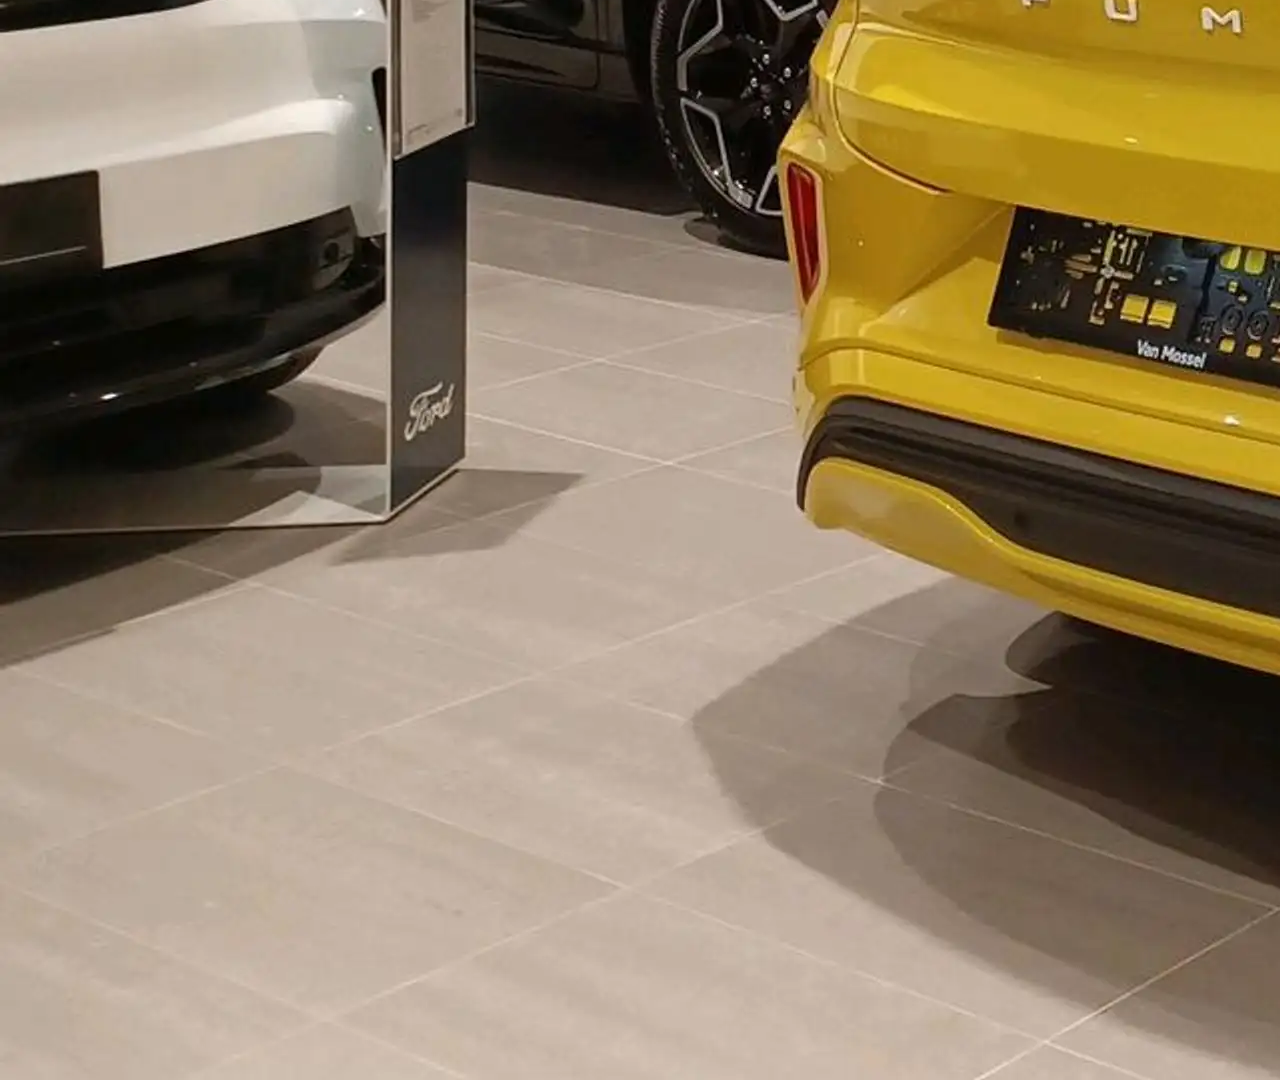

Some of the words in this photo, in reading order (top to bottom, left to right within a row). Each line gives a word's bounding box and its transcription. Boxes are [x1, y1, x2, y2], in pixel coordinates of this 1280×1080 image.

[1137, 338, 1160, 359] Van
[1161, 345, 1208, 369] Mossel
[404, 381, 455, 441] Ford
